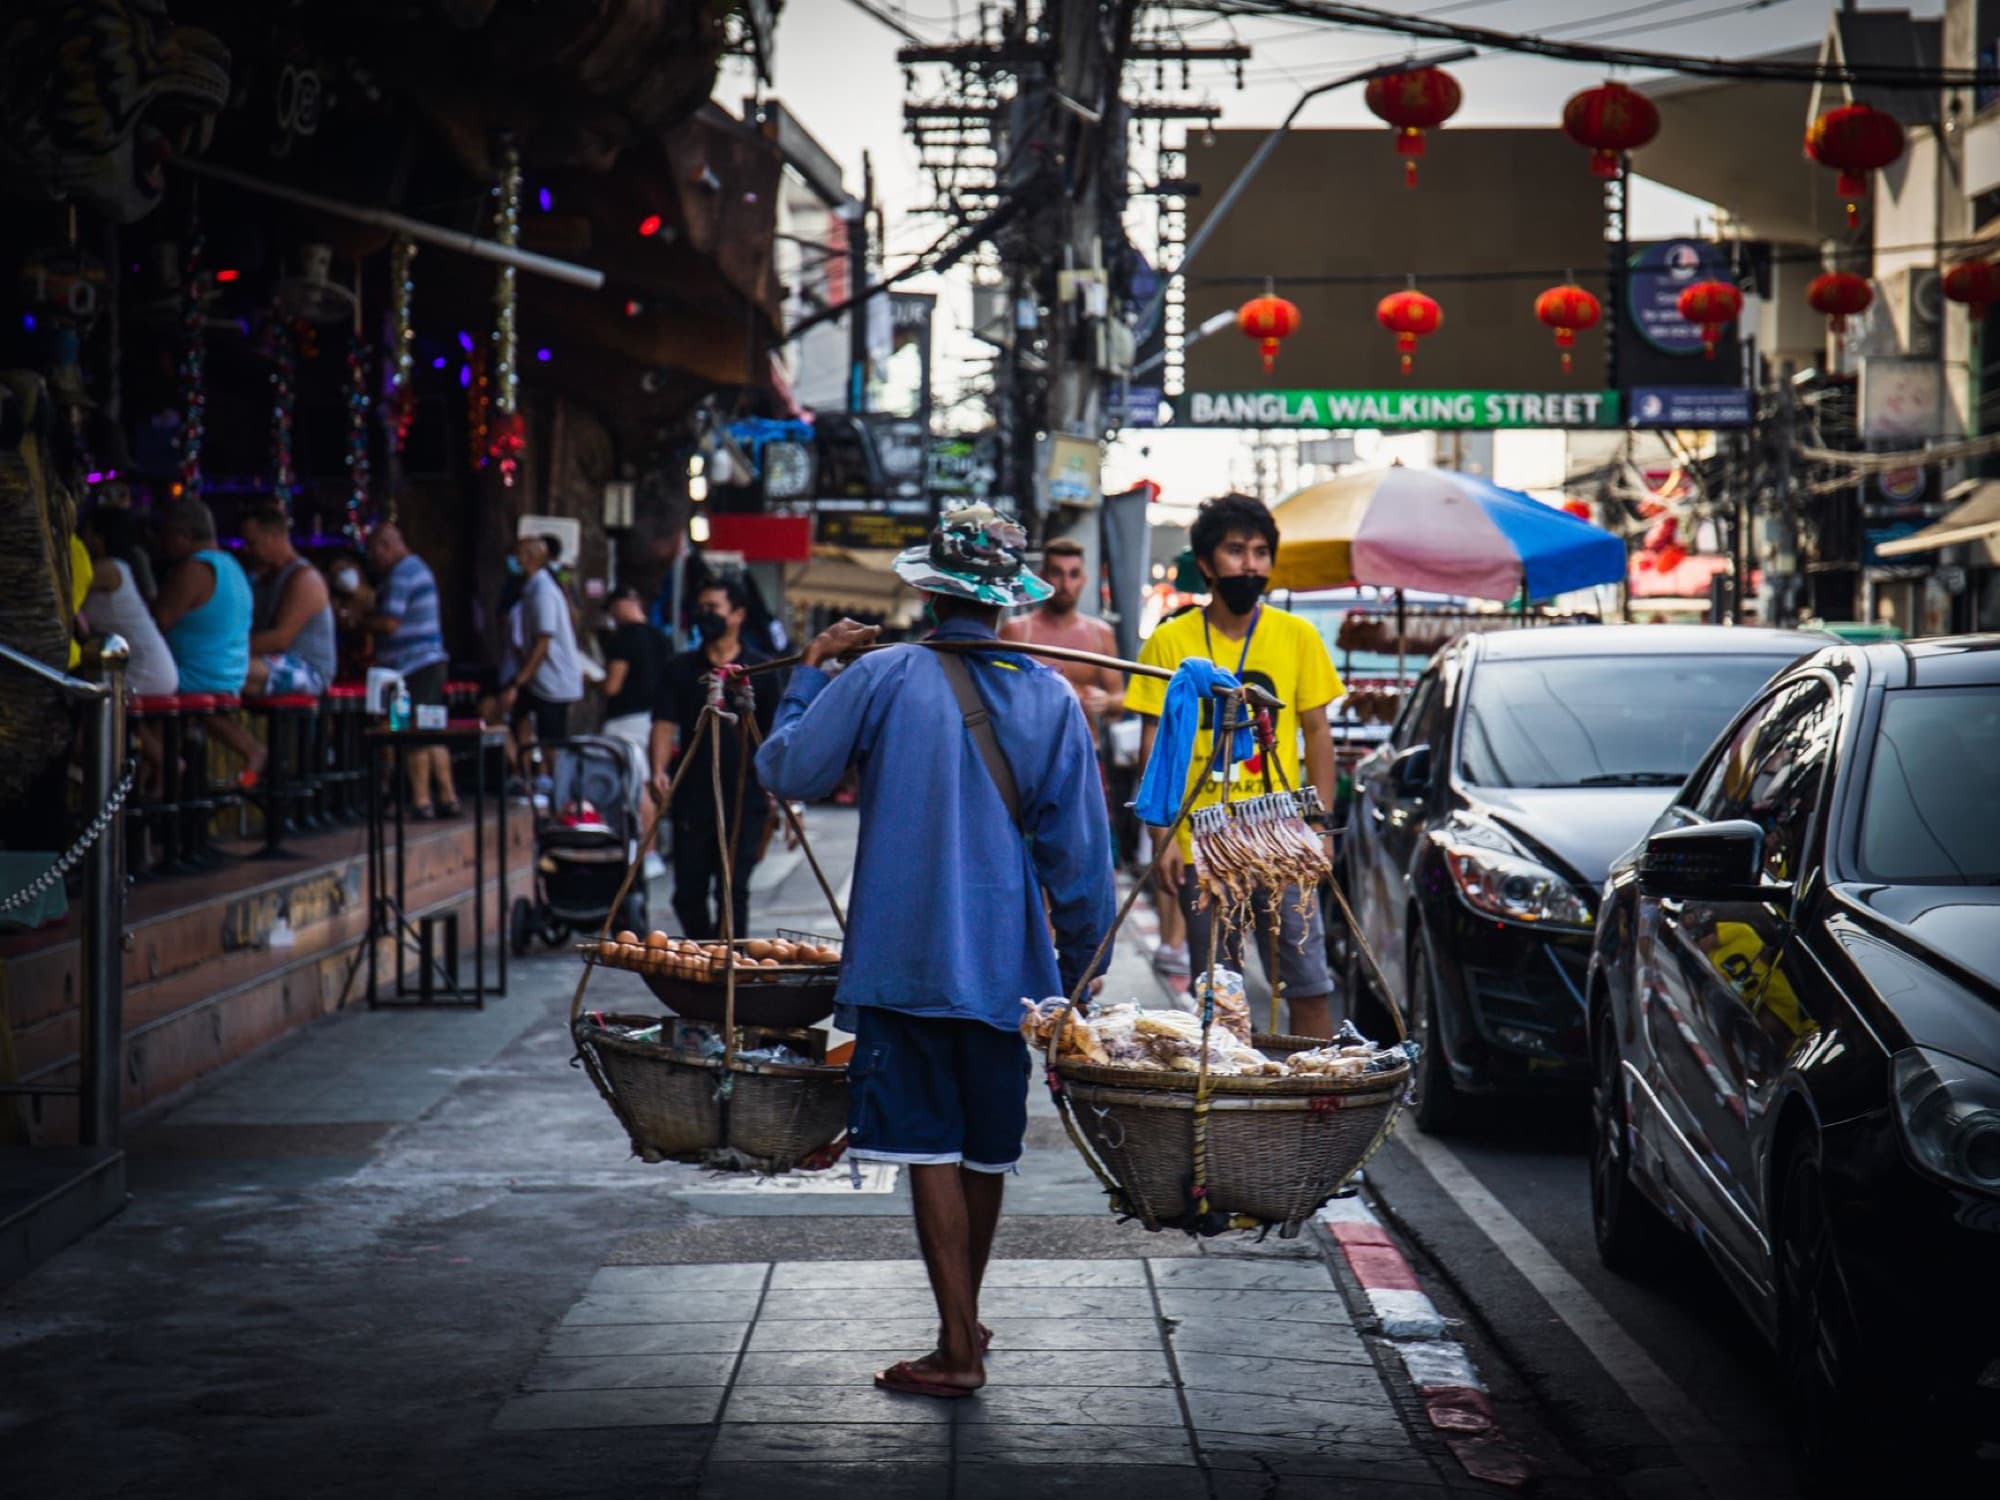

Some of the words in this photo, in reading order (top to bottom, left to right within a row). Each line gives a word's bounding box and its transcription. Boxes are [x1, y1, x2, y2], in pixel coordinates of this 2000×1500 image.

[1192, 393, 1319, 423] BANGLA
[1328, 393, 1476, 423] WALKING
[1485, 393, 1602, 423] STREET
